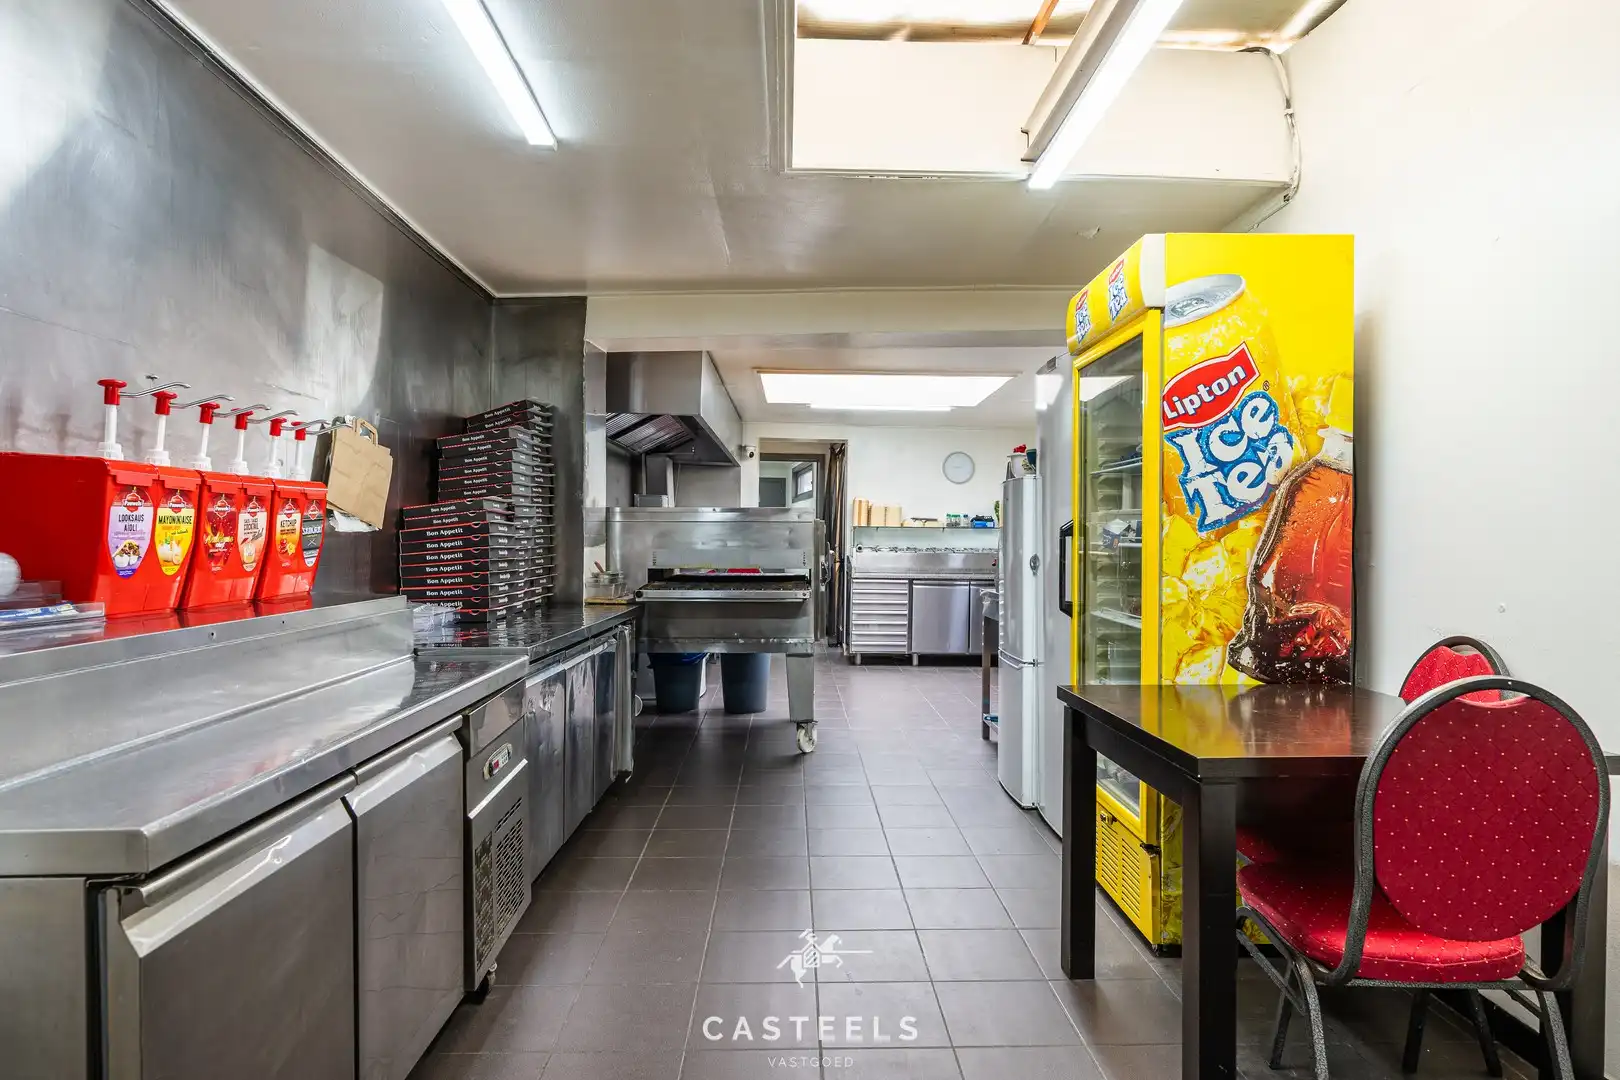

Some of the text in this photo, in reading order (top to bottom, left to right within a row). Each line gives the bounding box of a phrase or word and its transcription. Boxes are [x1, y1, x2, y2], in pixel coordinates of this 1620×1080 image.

[1163, 365, 1247, 419] Lipton
[1169, 395, 1276, 475] Ice
[1183, 431, 1293, 525] Tea
[118, 514, 144, 522] LOOKSAUS
[280, 519, 297, 527] KETCHUP
